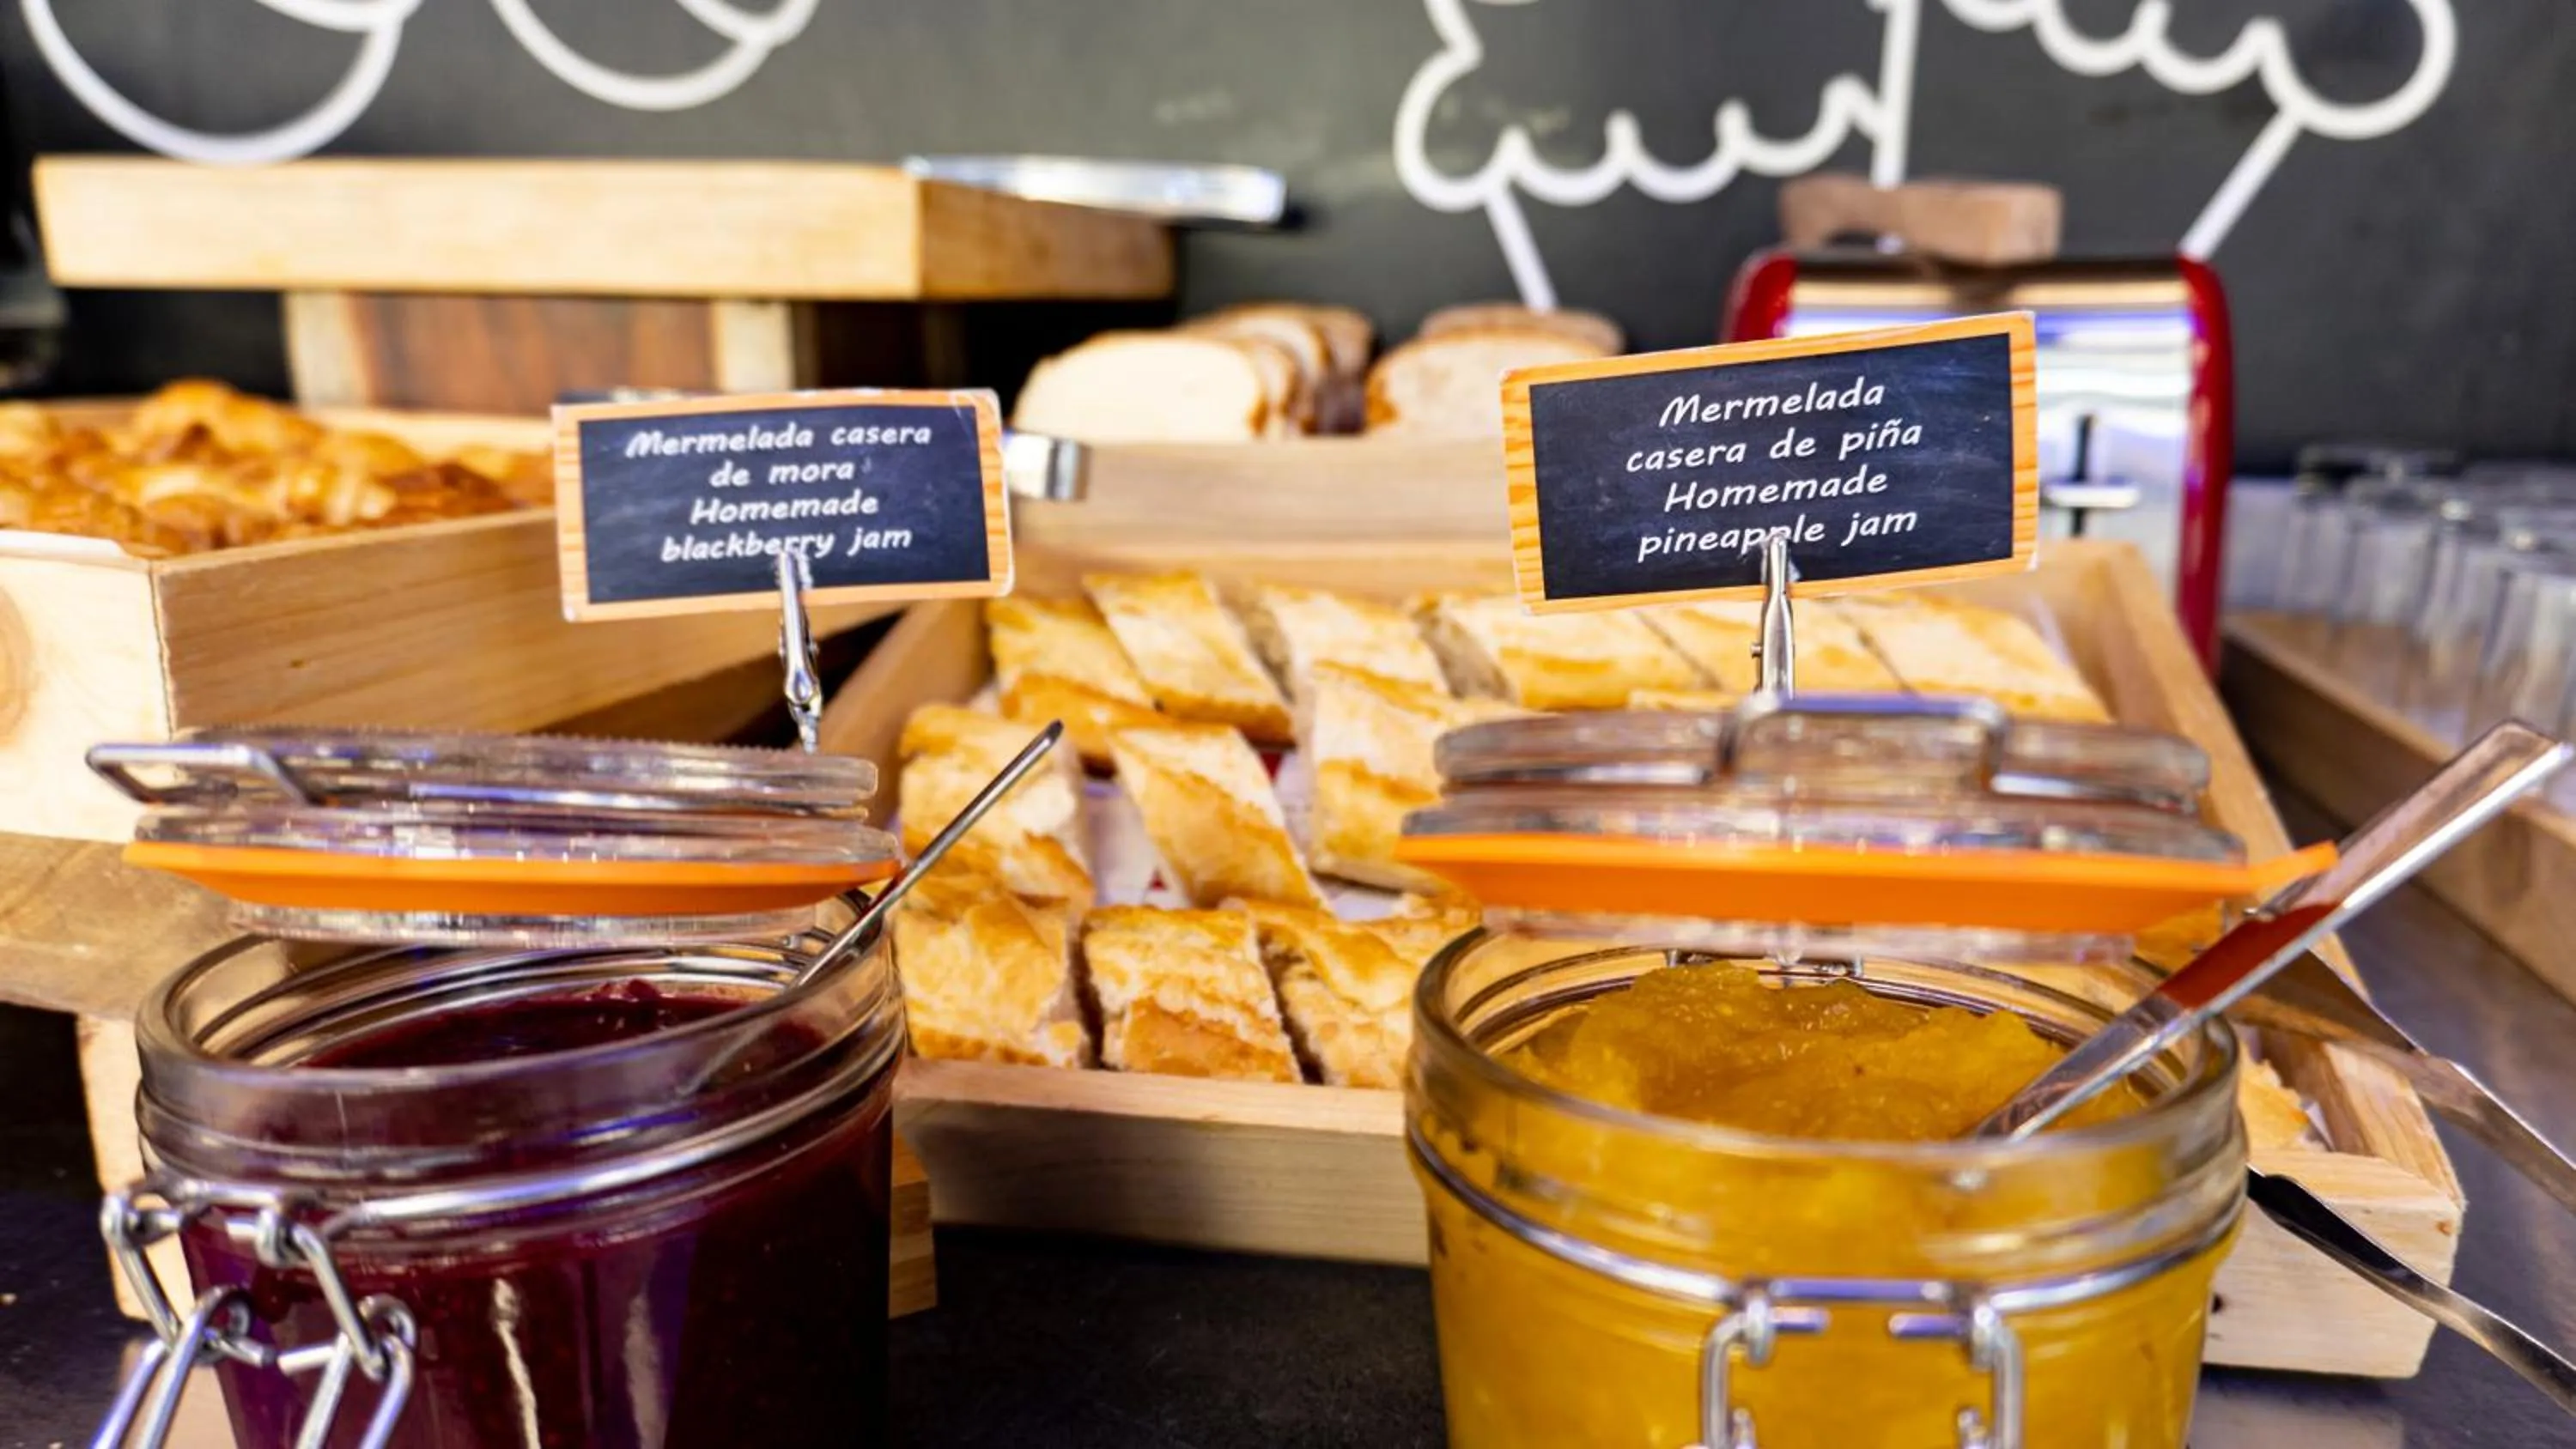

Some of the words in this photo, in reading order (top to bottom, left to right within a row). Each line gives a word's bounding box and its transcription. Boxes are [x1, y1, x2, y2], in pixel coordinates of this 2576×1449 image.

[1659, 376, 1885, 427] Mermelada
[624, 422, 814, 458] Mermelada
[829, 424, 932, 446] casera
[1625, 442, 1747, 473] casera
[1769, 427, 1816, 459] de
[1838, 418, 1923, 461] piña
[709, 460, 750, 487] de
[768, 462, 855, 483] mora
[1664, 464, 1889, 512] Homemade
[690, 488, 878, 524] Homemade
[660, 532, 835, 562] blackberry
[847, 526, 912, 557] jam
[1842, 510, 1917, 547] jam
